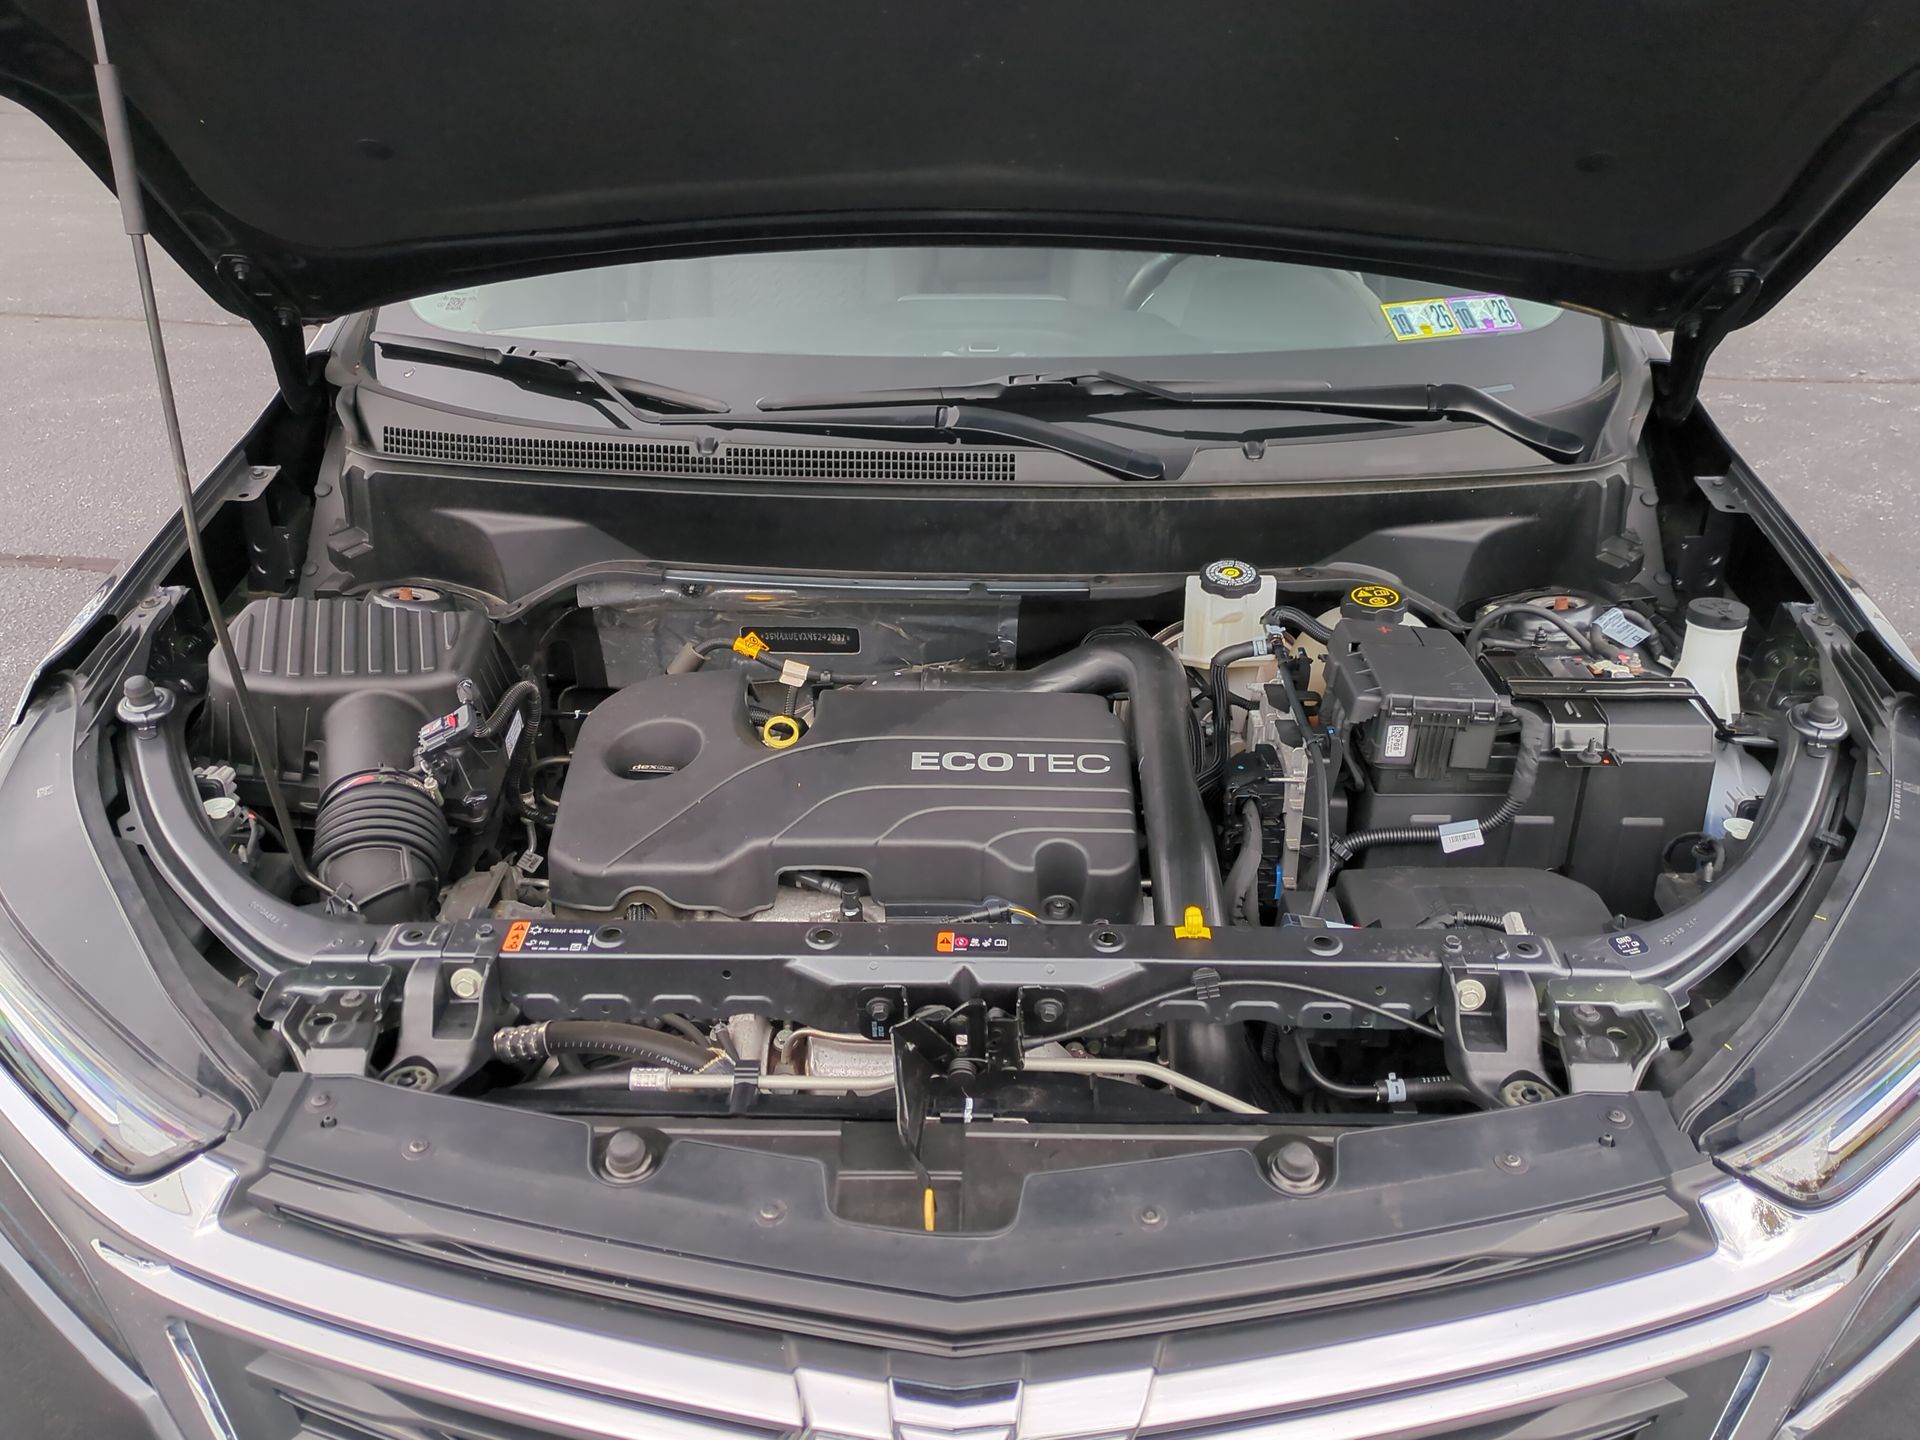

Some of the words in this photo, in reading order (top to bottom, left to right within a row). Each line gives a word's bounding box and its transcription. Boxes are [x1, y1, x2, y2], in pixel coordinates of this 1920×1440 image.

[1430, 304, 1454, 329] 26
[1491, 299, 1515, 323] 26
[911, 752, 1111, 774] ECOTEC
